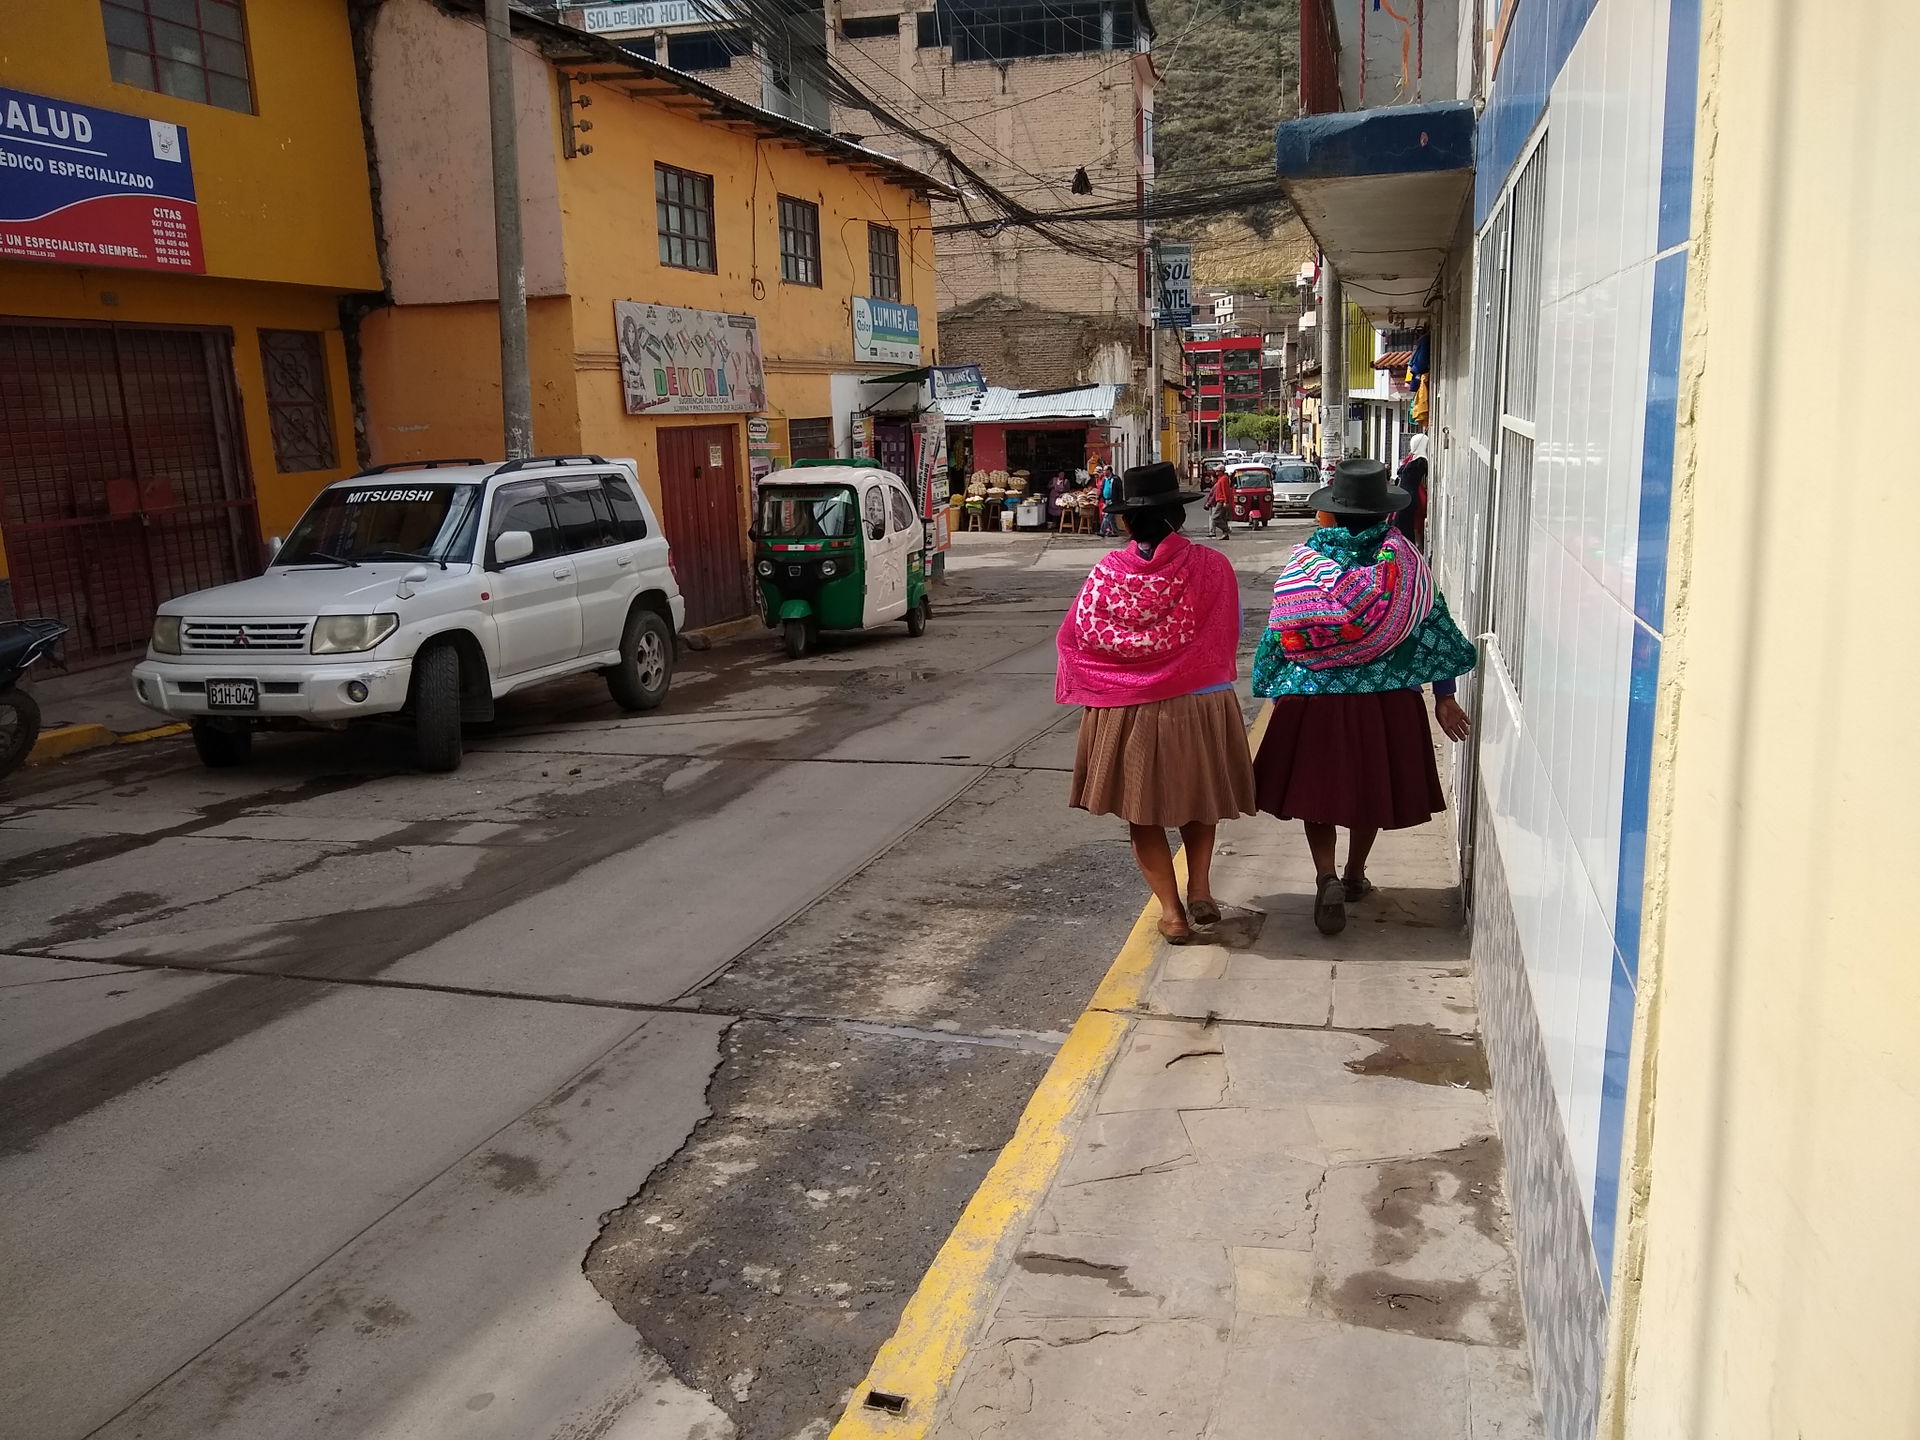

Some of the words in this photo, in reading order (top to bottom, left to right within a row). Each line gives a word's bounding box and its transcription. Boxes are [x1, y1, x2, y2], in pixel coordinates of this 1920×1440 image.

[587, 11, 613, 29] SOL
[614, 10, 628, 24] DE
[628, 6, 654, 25] ORO
[48, 159, 154, 189] ESPECIALIZADO
[153, 207, 182, 220] CITAS
[6, 234, 22, 246] UN
[25, 236, 96, 254] ESPECIALISTA
[1163, 263, 1190, 281] SOL
[873, 306, 908, 332] LUMINEX
[653, 366, 729, 397] DEKORA
[346, 490, 434, 504] MITSUBISHI
[211, 687, 255, 704] B1H-042
